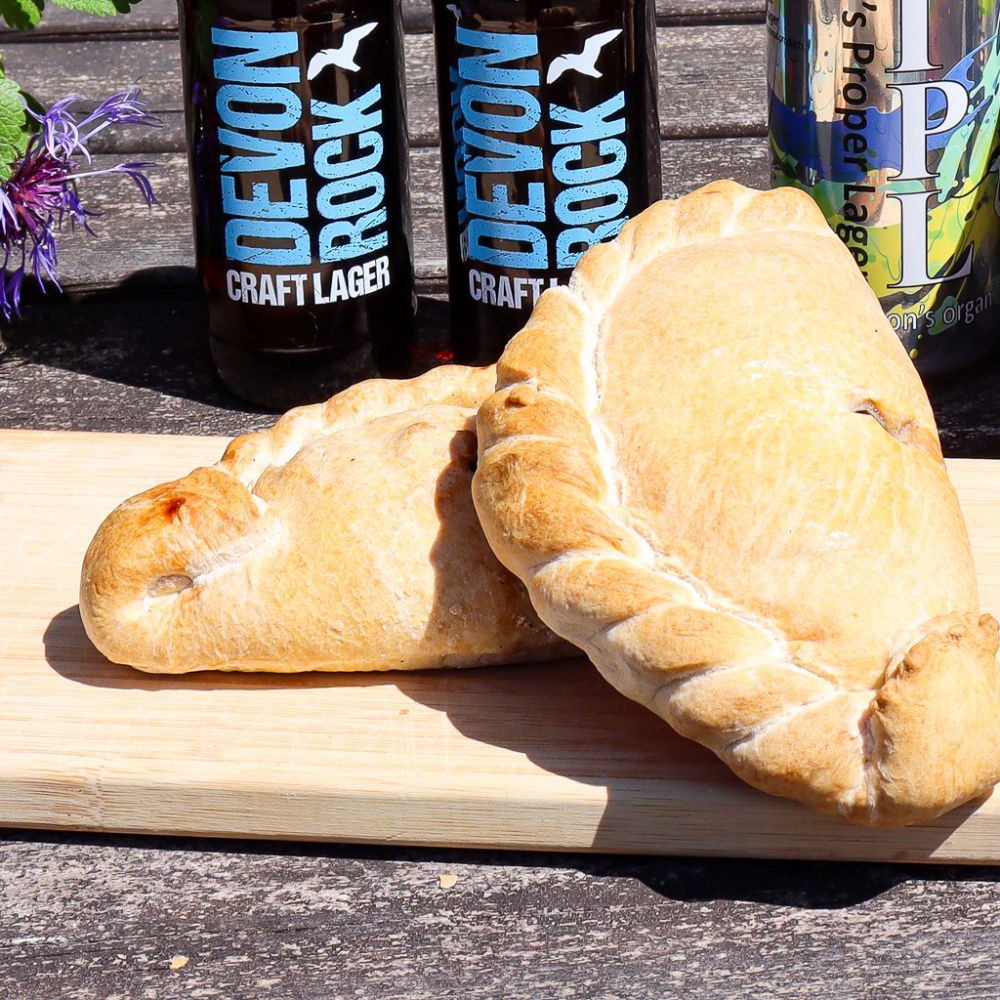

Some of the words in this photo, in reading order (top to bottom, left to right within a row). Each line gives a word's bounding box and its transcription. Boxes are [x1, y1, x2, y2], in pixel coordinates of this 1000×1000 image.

[211, 27, 312, 265] DEVON
[310, 83, 389, 264] ROCK
[456, 27, 549, 270] DEVON
[834, 41, 876, 174] Proper
[550, 91, 630, 269] ROCK
[835, 184, 876, 281] Lage
[226, 269, 308, 306] CRAFT
[313, 255, 391, 305] LAGER
[468, 269, 544, 310] CRAFT
[887, 305, 935, 330] on's
